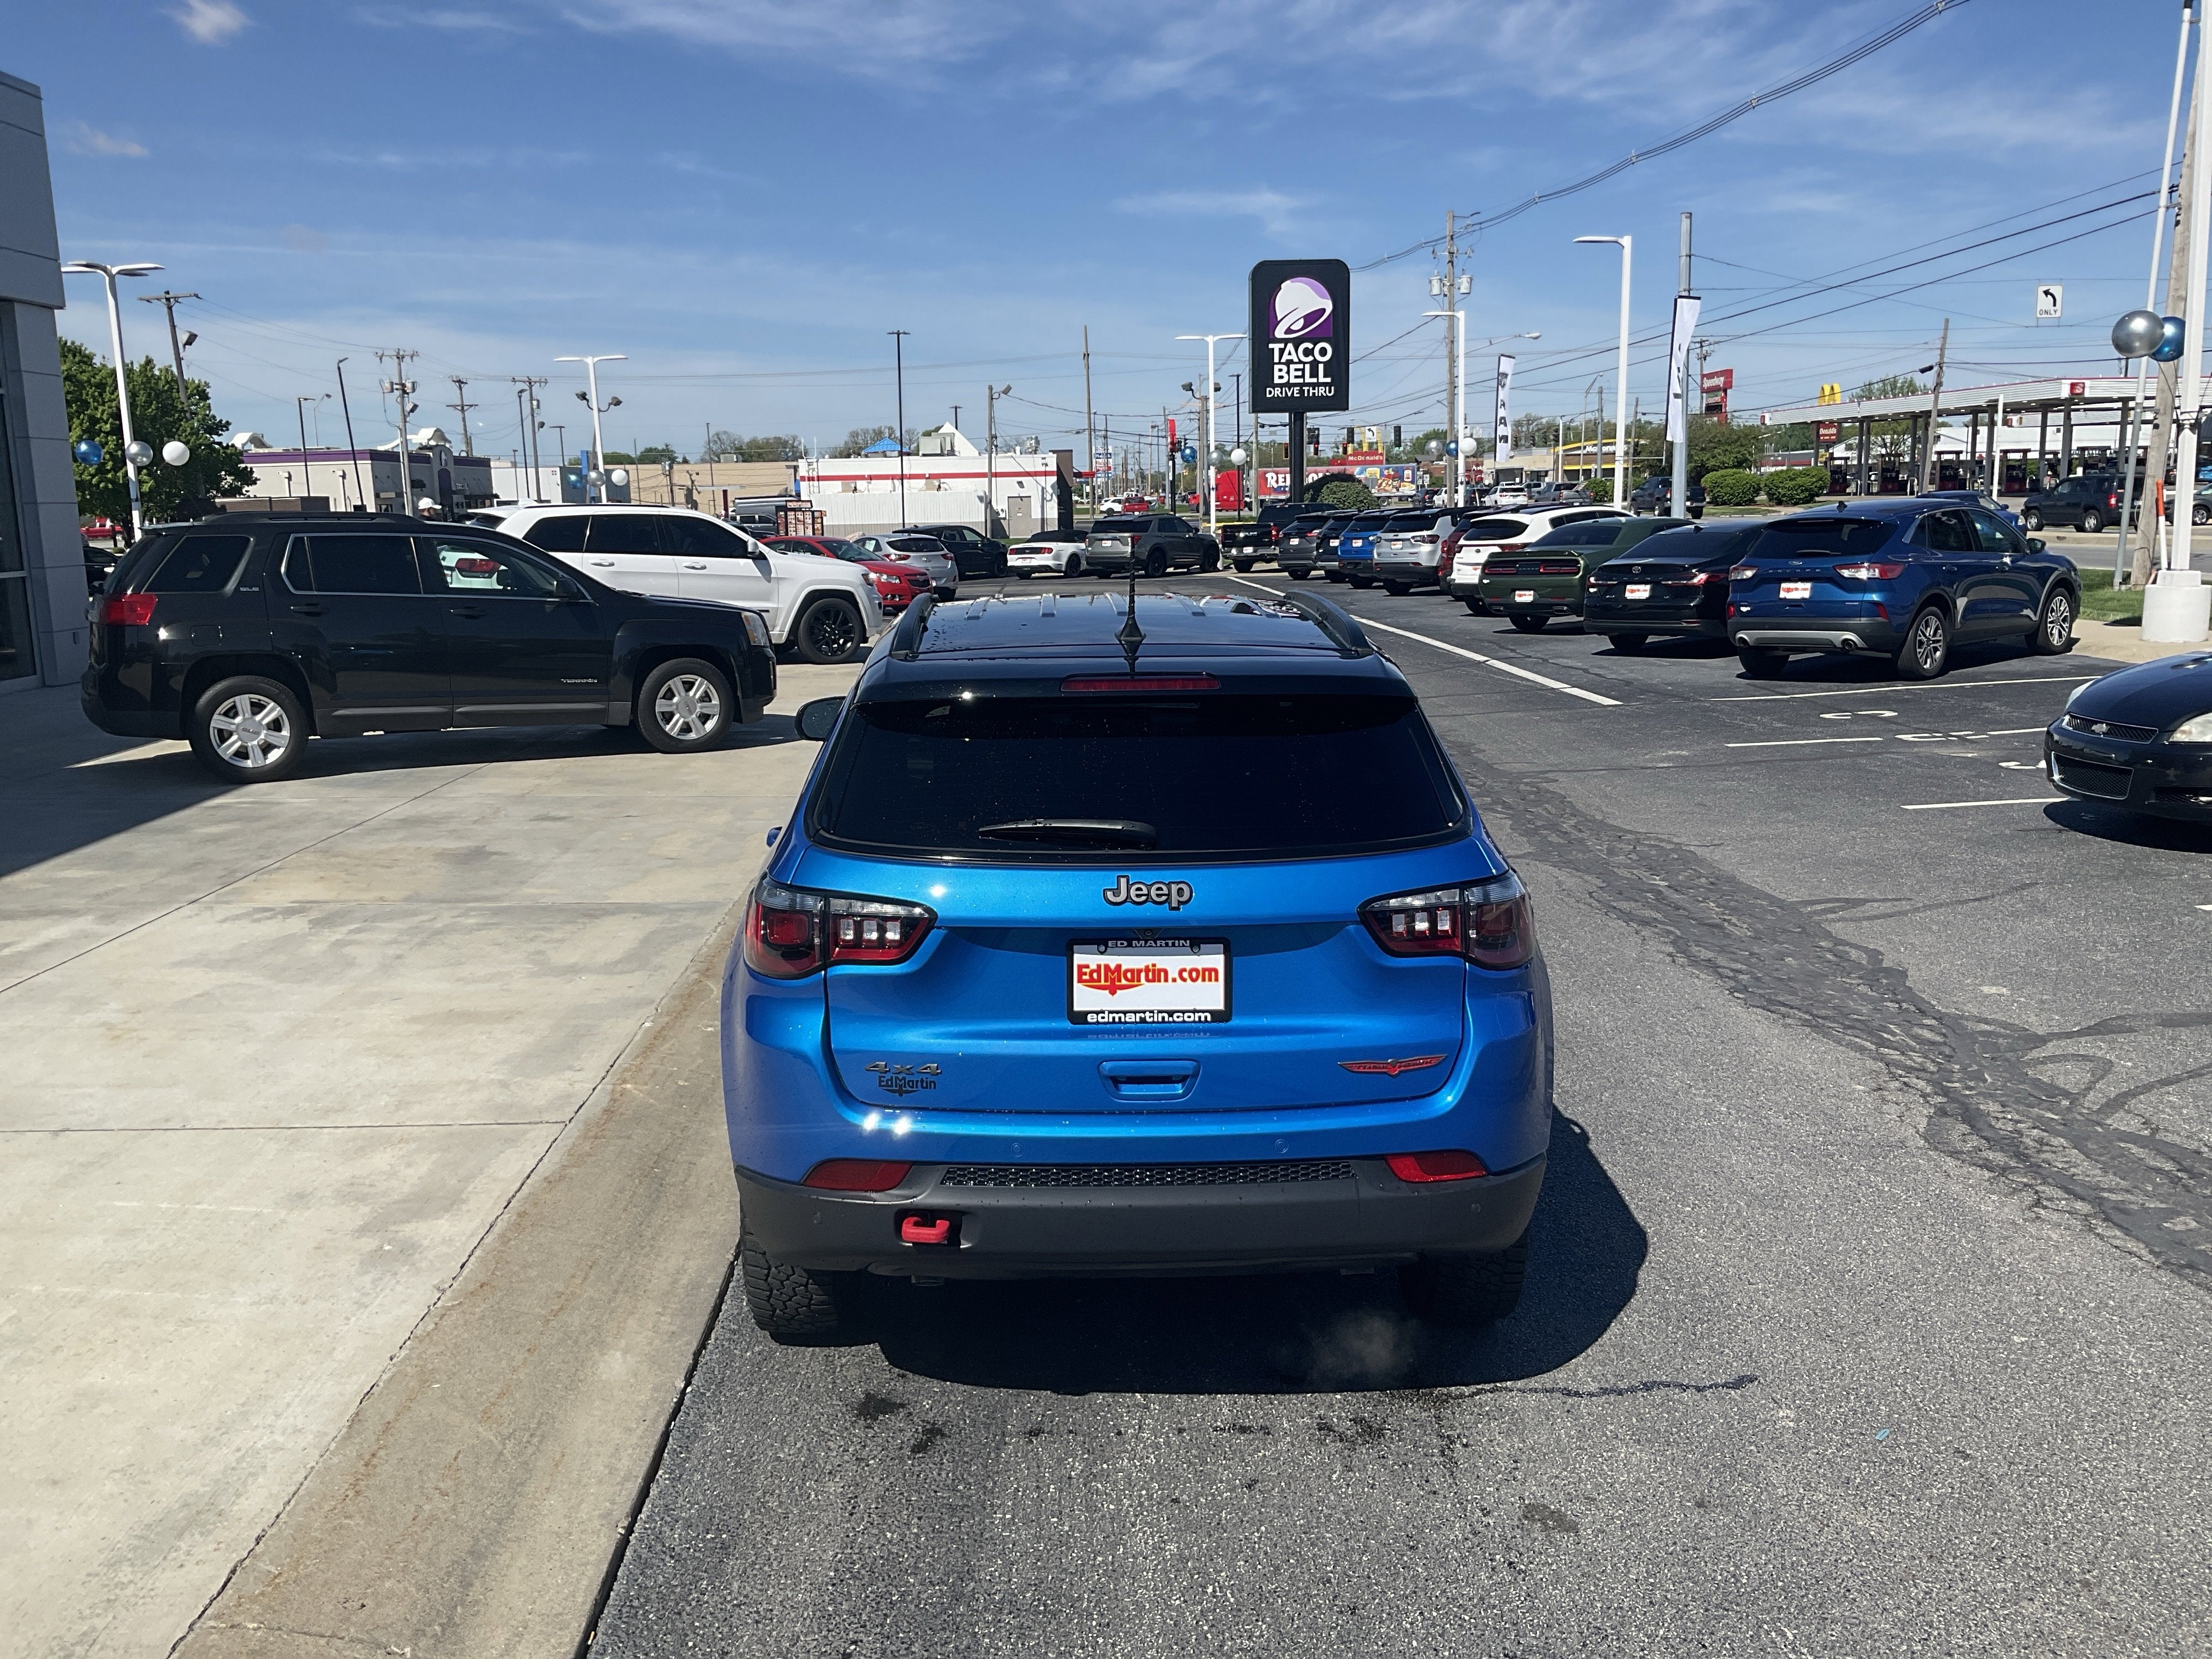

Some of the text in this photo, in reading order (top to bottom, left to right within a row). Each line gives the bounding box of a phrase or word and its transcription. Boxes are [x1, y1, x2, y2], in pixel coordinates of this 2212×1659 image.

[1268, 342, 1333, 363] TACO
[1273, 364, 1331, 384] BELL
[1702, 376, 1725, 390] Speedway
[1266, 386, 1334, 398] DRIVE THRU
[1103, 874, 1195, 911] Jeep
[1076, 963, 1219, 991] EdMartin.com
[1087, 1010, 1211, 1023] edmartin.com
[865, 1061, 942, 1075] 4x4
[878, 1075, 936, 1094] EdMartin
